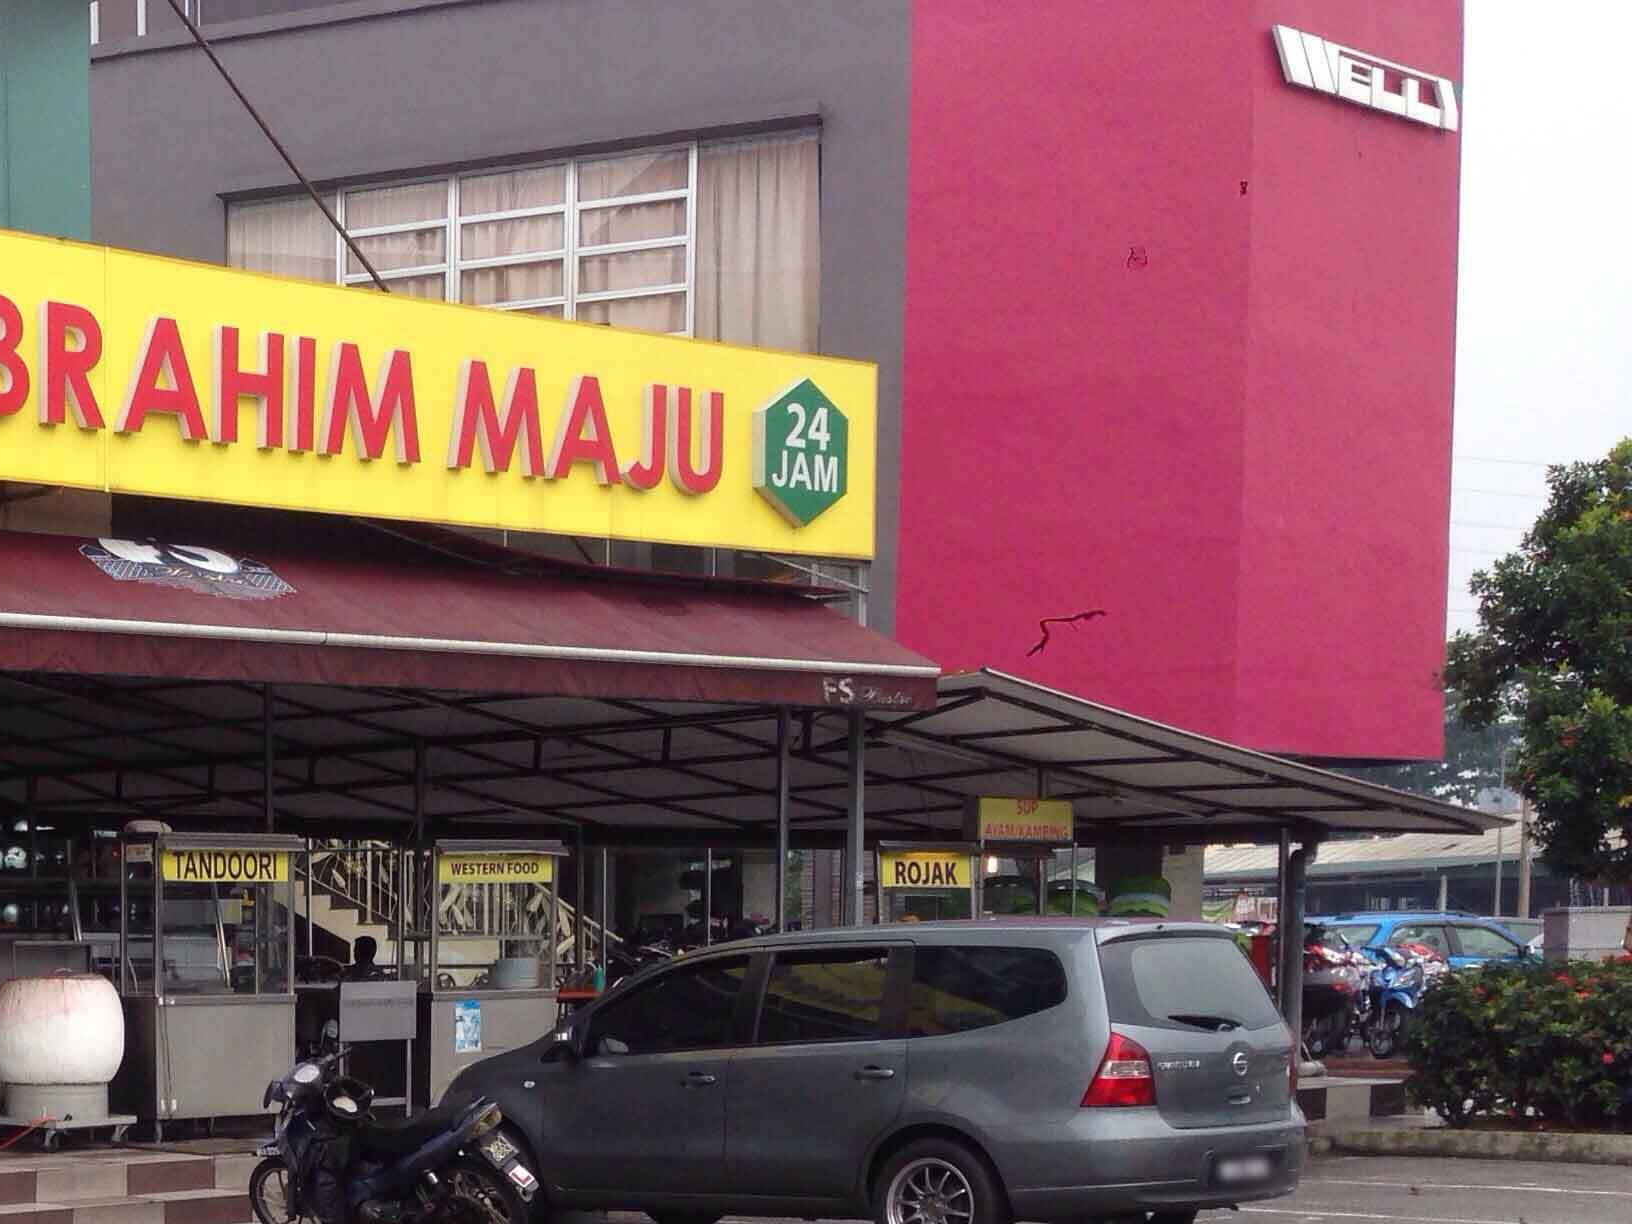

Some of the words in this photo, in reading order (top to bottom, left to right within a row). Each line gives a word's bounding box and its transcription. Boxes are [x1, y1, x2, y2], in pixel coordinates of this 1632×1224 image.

[447, 360, 725, 495] MAJU
[784, 402, 831, 450] 24
[772, 451, 839, 493] JAM
[172, 849, 278, 880] TANDOORI
[451, 862, 505, 876] WESTERN
[507, 862, 540, 875] FOOD
[894, 861, 958, 886] ROJAK
